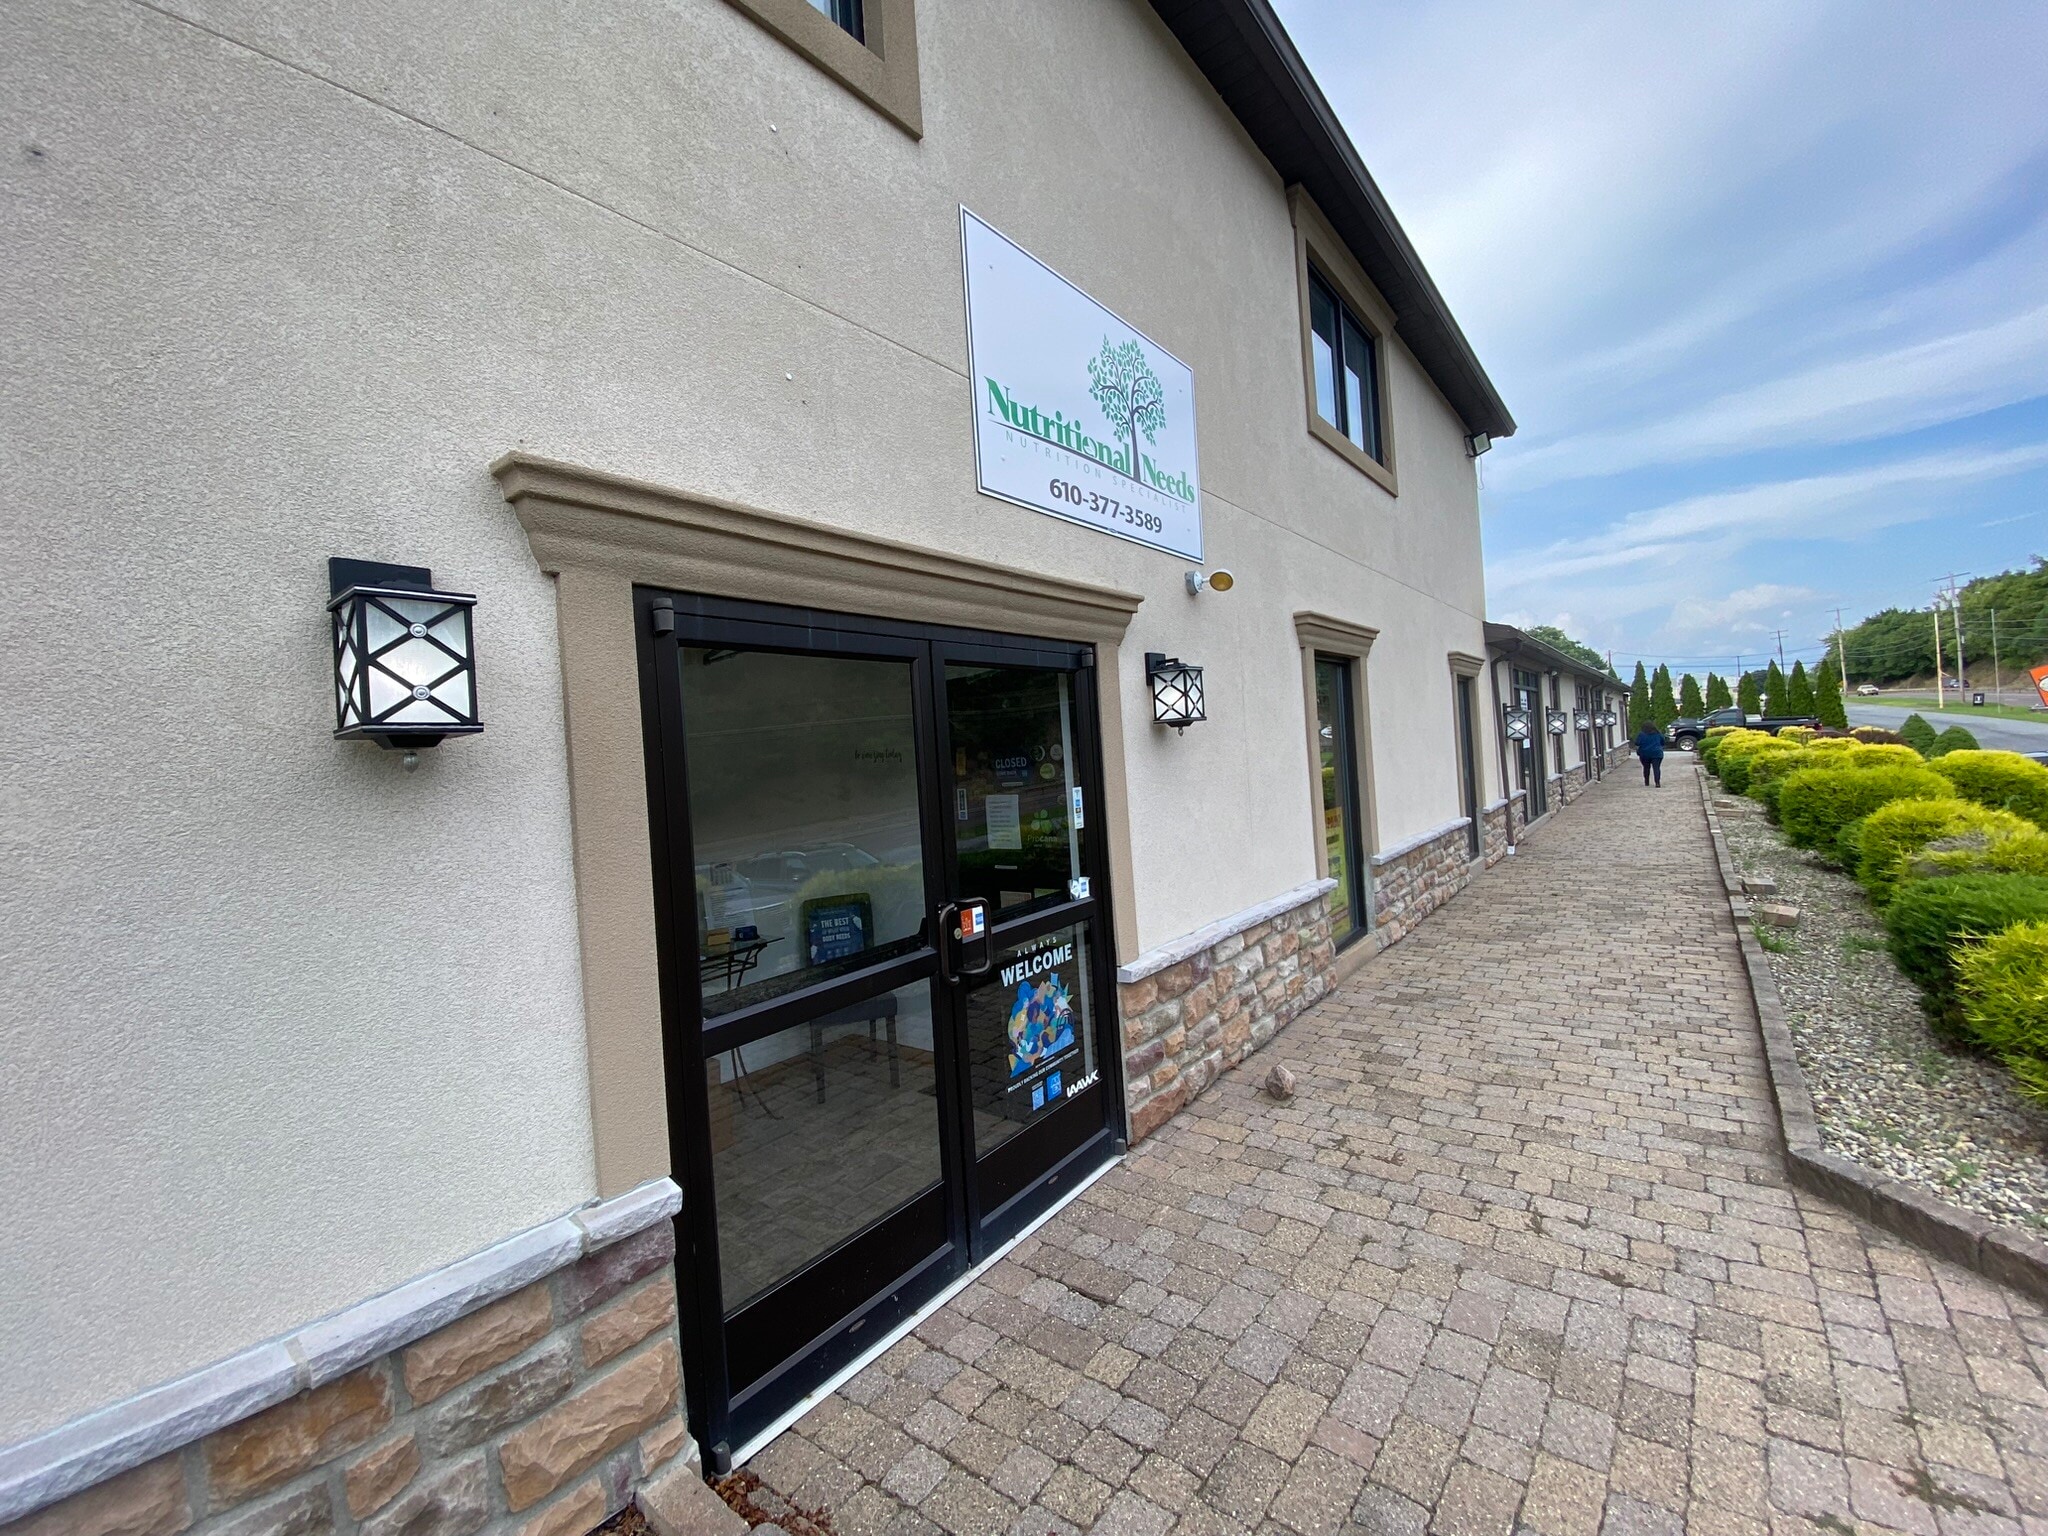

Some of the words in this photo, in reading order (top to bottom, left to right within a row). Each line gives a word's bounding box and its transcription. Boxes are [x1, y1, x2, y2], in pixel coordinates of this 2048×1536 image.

[984, 376, 1132, 475] Nutritional
[1141, 453, 1195, 503] Needs
[1005, 430, 1101, 479] NUTRITION
[1112, 475, 1186, 513] SPECIALIST
[1050, 478, 1162, 533] 610-377-3589
[995, 757, 1027, 769] CLOSED
[821, 919, 833, 928] THE
[833, 916, 849, 927] BEST
[1000, 943, 1072, 987] WELCOME
[1017, 936, 1056, 957] ALWAYS
